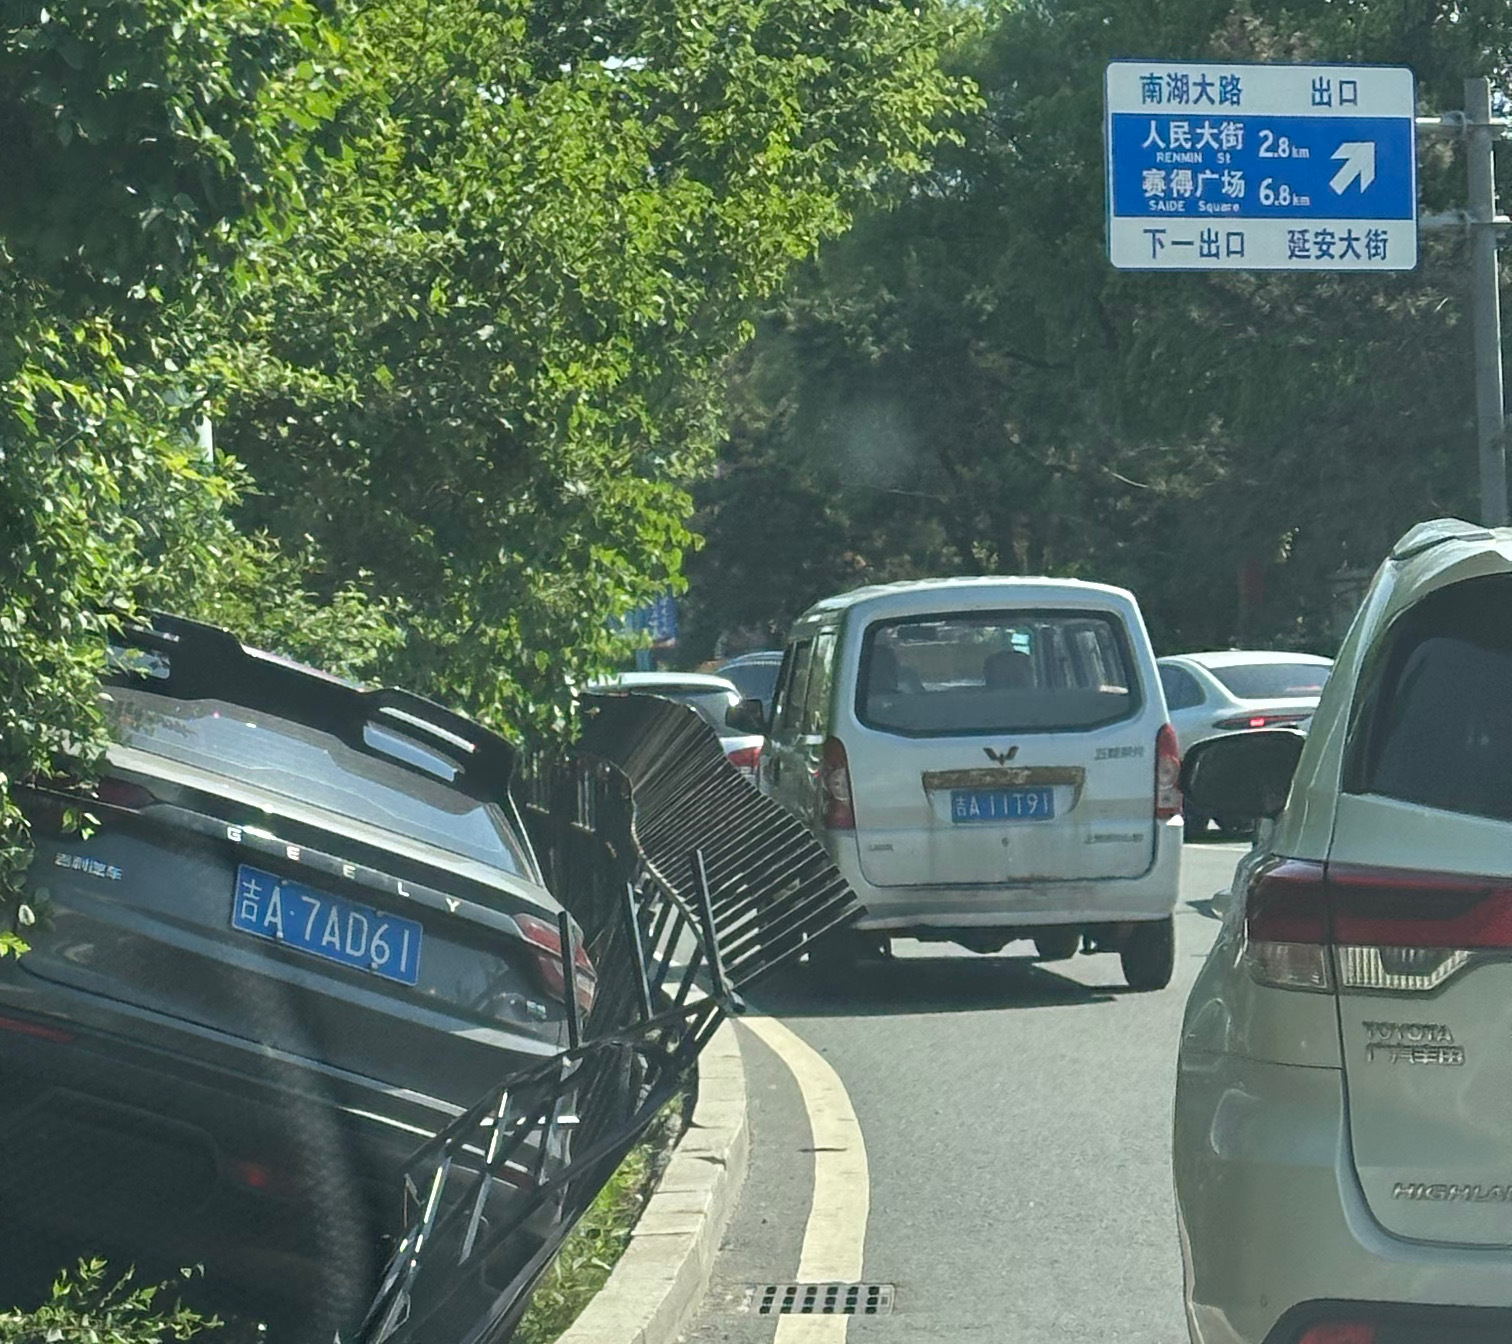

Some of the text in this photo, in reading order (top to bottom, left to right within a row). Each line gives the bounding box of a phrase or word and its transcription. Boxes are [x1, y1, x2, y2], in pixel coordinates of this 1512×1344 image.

[1140, 72, 1358, 107] 南湖大路 出口
[1142, 120, 1245, 150] 人民大街
[1156, 152, 1231, 164] RENMIN St
[1142, 168, 1245, 198] 赛得广场
[1149, 200, 1240, 214] SAIDE Square
[1143, 227, 1388, 261] 下一出口 延安大街
[227, 826, 461, 913] GEELY
[1362, 1021, 1454, 1044] TOYOTA
